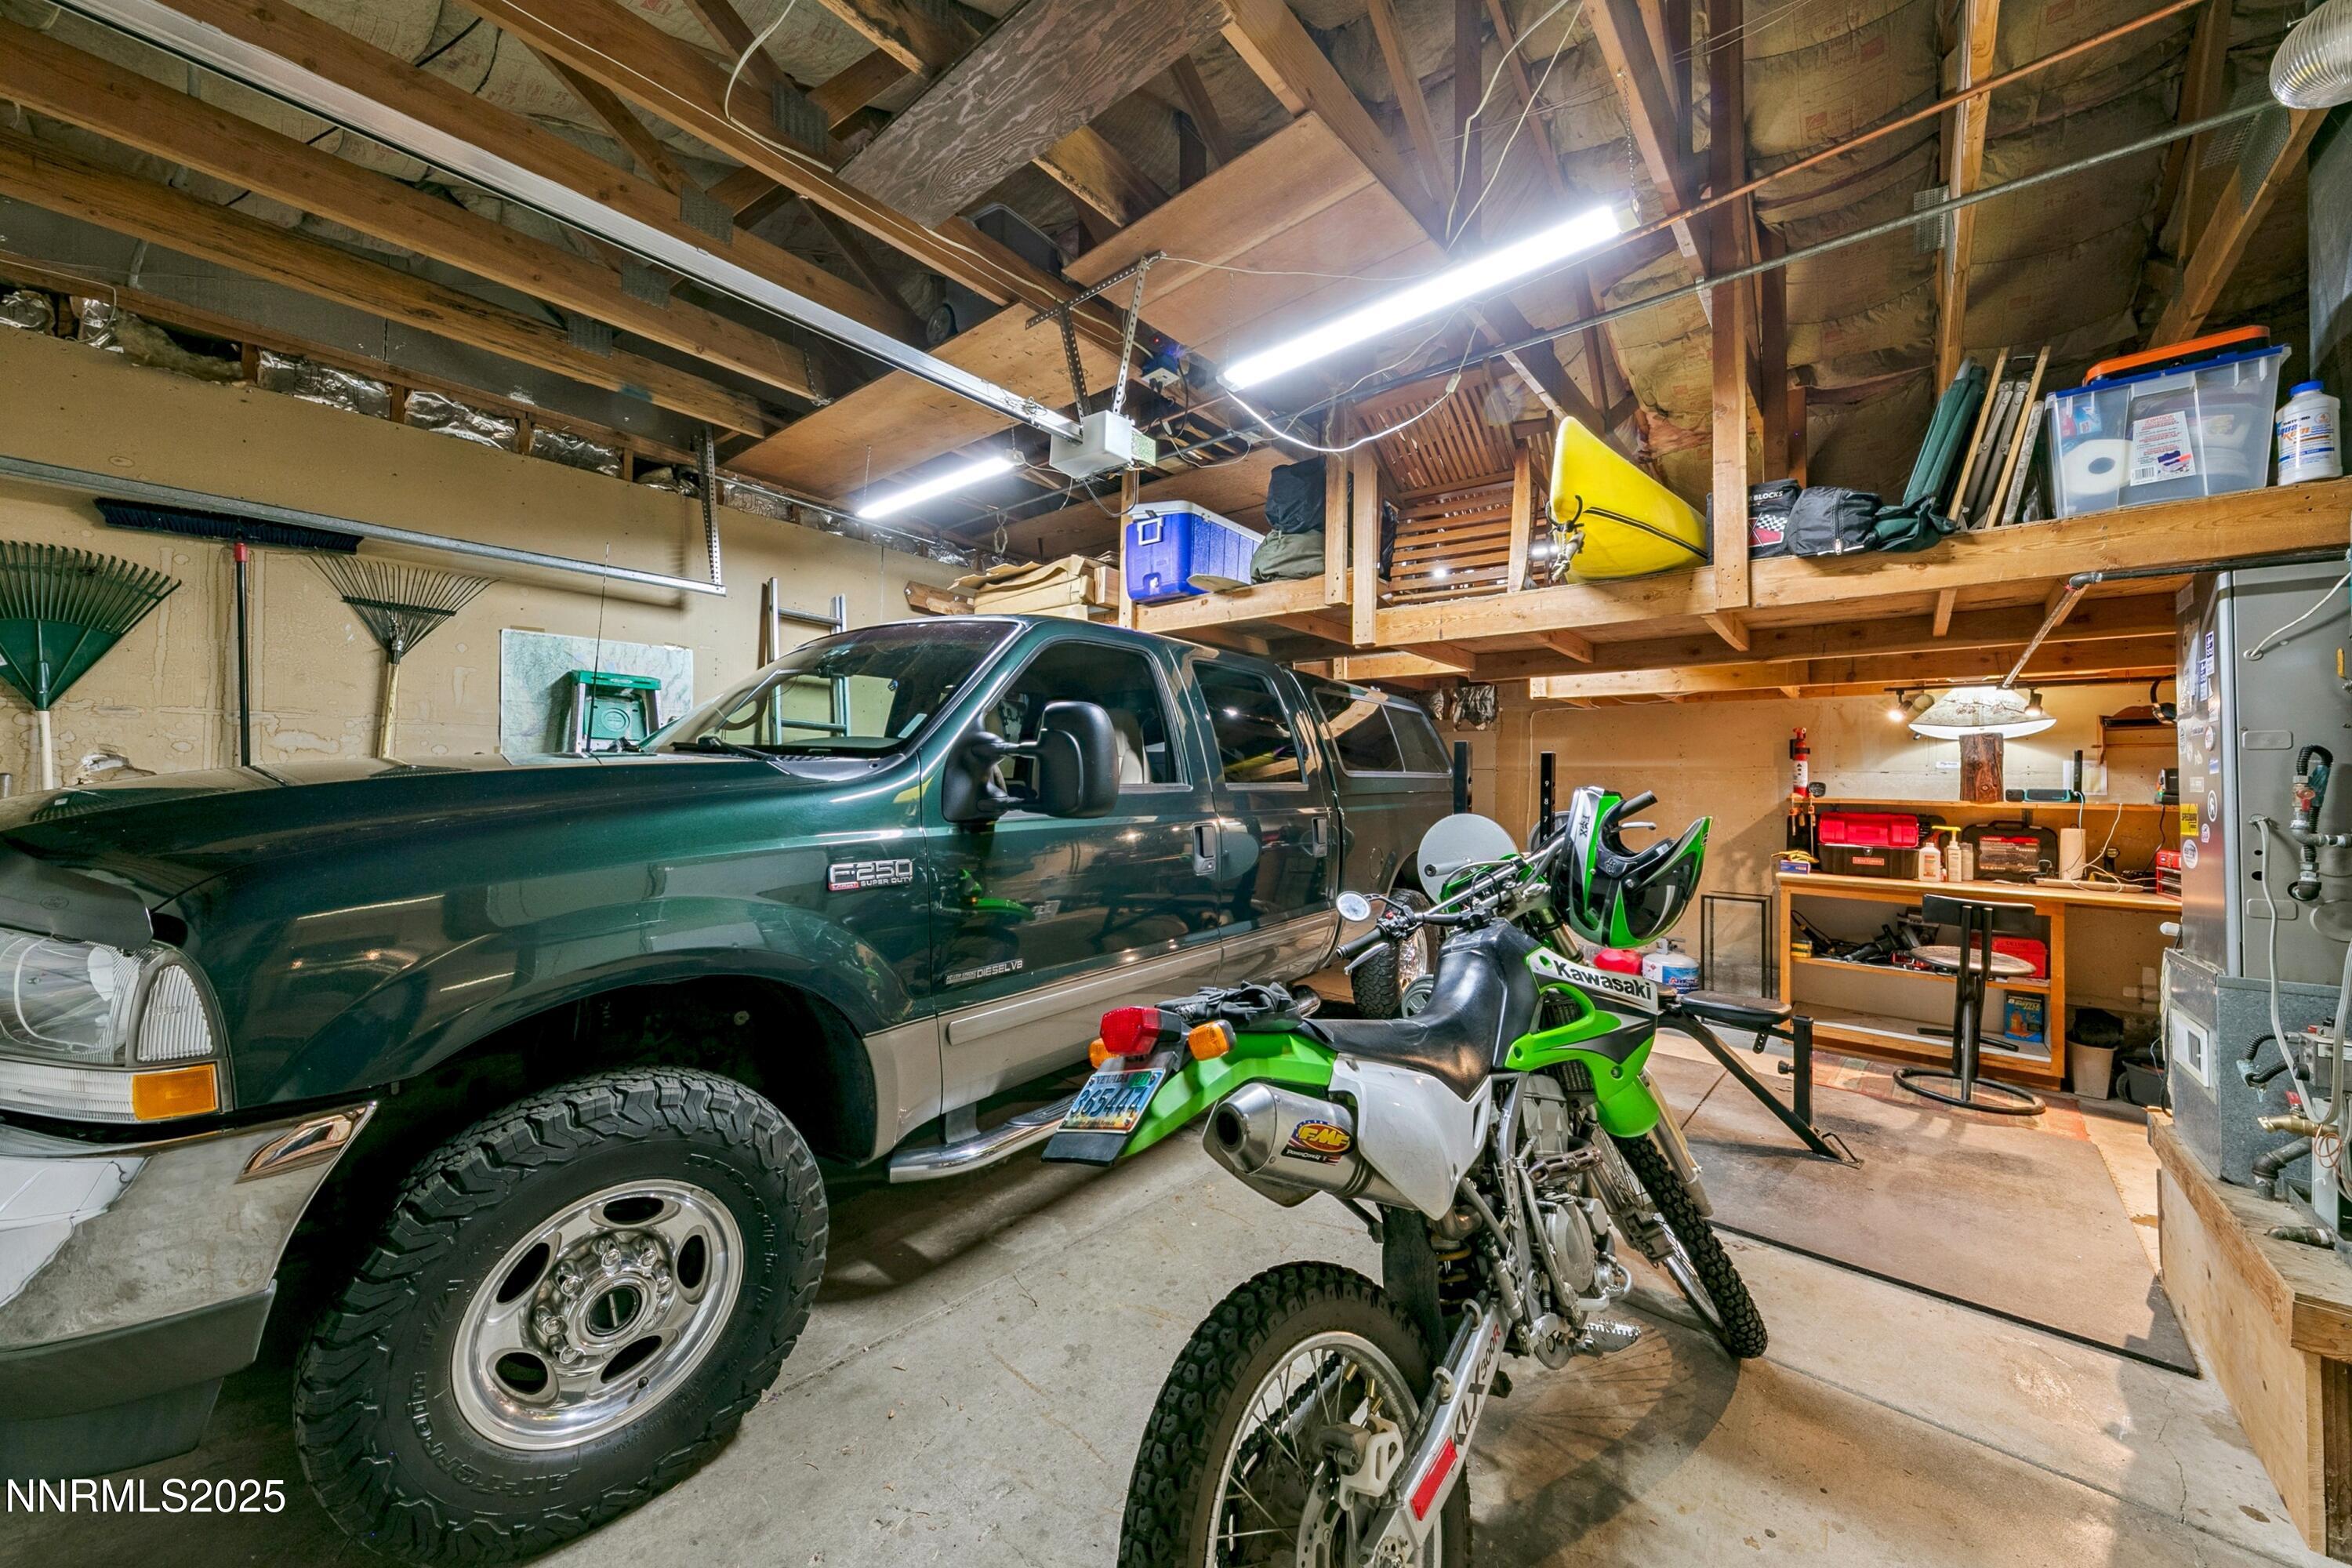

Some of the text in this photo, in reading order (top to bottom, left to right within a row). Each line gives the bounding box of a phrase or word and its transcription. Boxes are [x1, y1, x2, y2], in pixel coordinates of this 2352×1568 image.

[1753, 491, 1784, 501] BLOCKS
[977, 962, 1010, 978] DIESEL
[1011, 960, 1023, 971] V8
[1553, 960, 1651, 1000] Kawasaki
[1070, 1086, 1149, 1117] 365444
[1298, 1127, 1350, 1146] FMF
